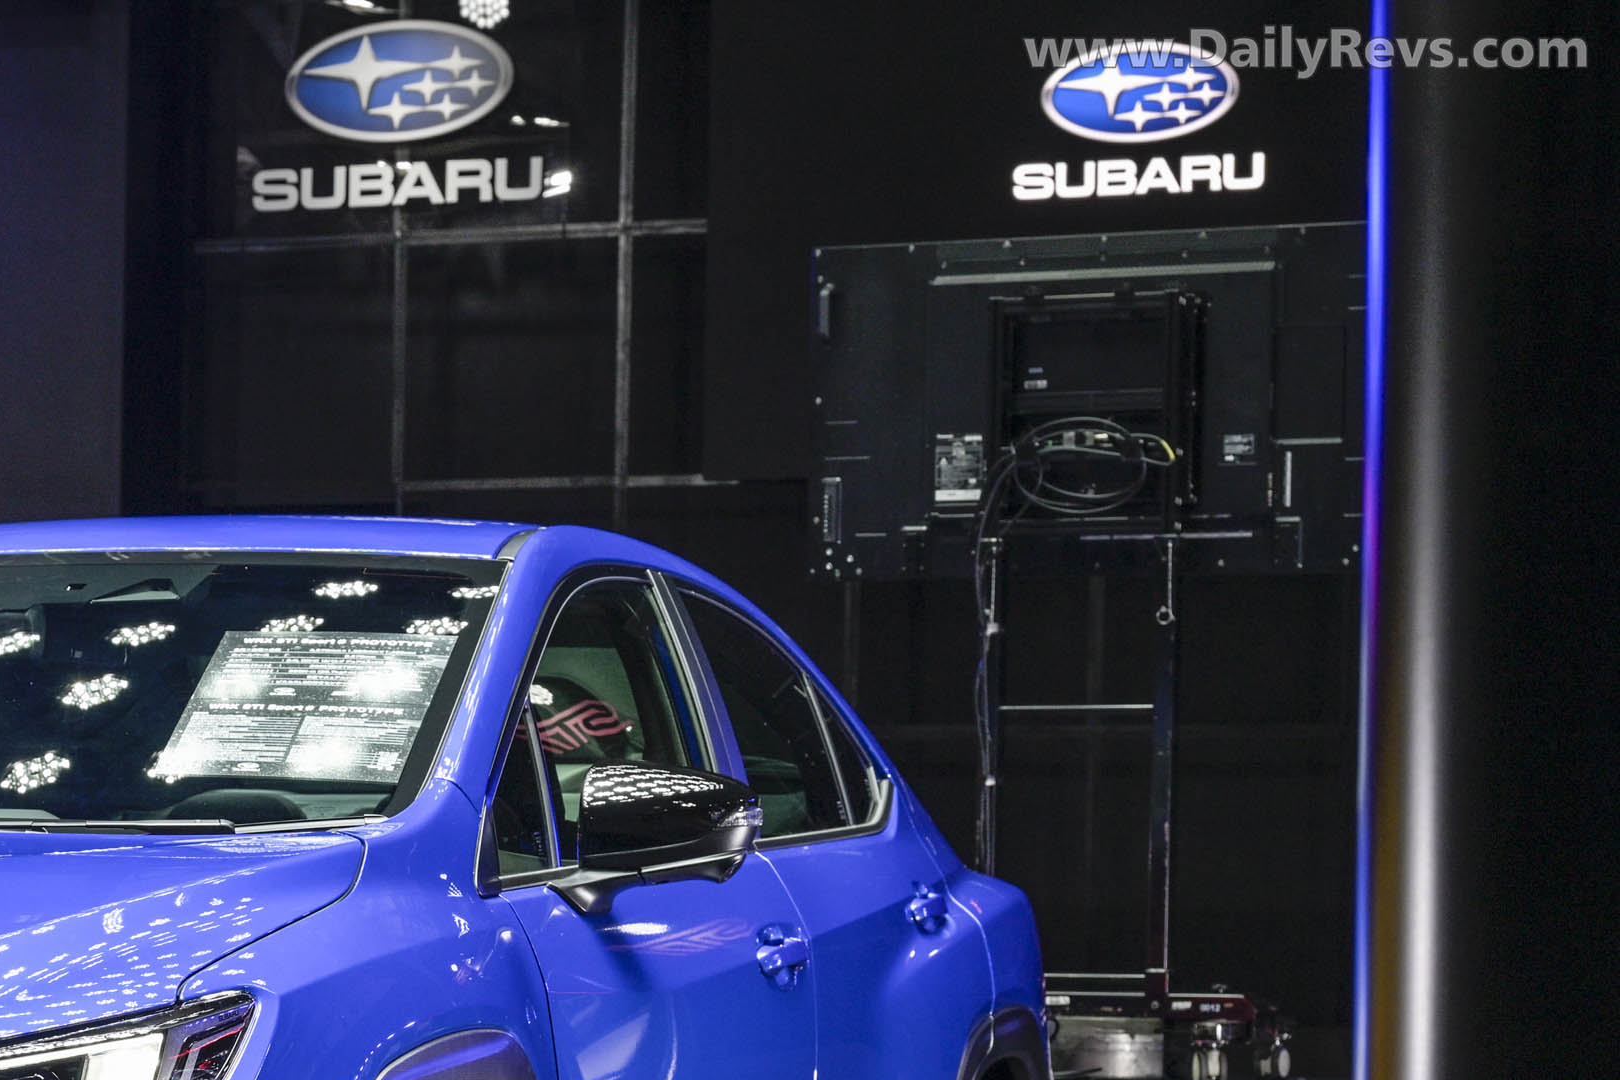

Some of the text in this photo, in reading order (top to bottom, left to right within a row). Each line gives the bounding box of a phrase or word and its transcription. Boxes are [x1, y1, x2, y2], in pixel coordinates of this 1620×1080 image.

[252, 155, 544, 212] SUBARU
[1012, 152, 1266, 200] SUBARU
[350, 638, 434, 648] PROTOTYPE
[318, 704, 405, 715] PROTOTYPE
